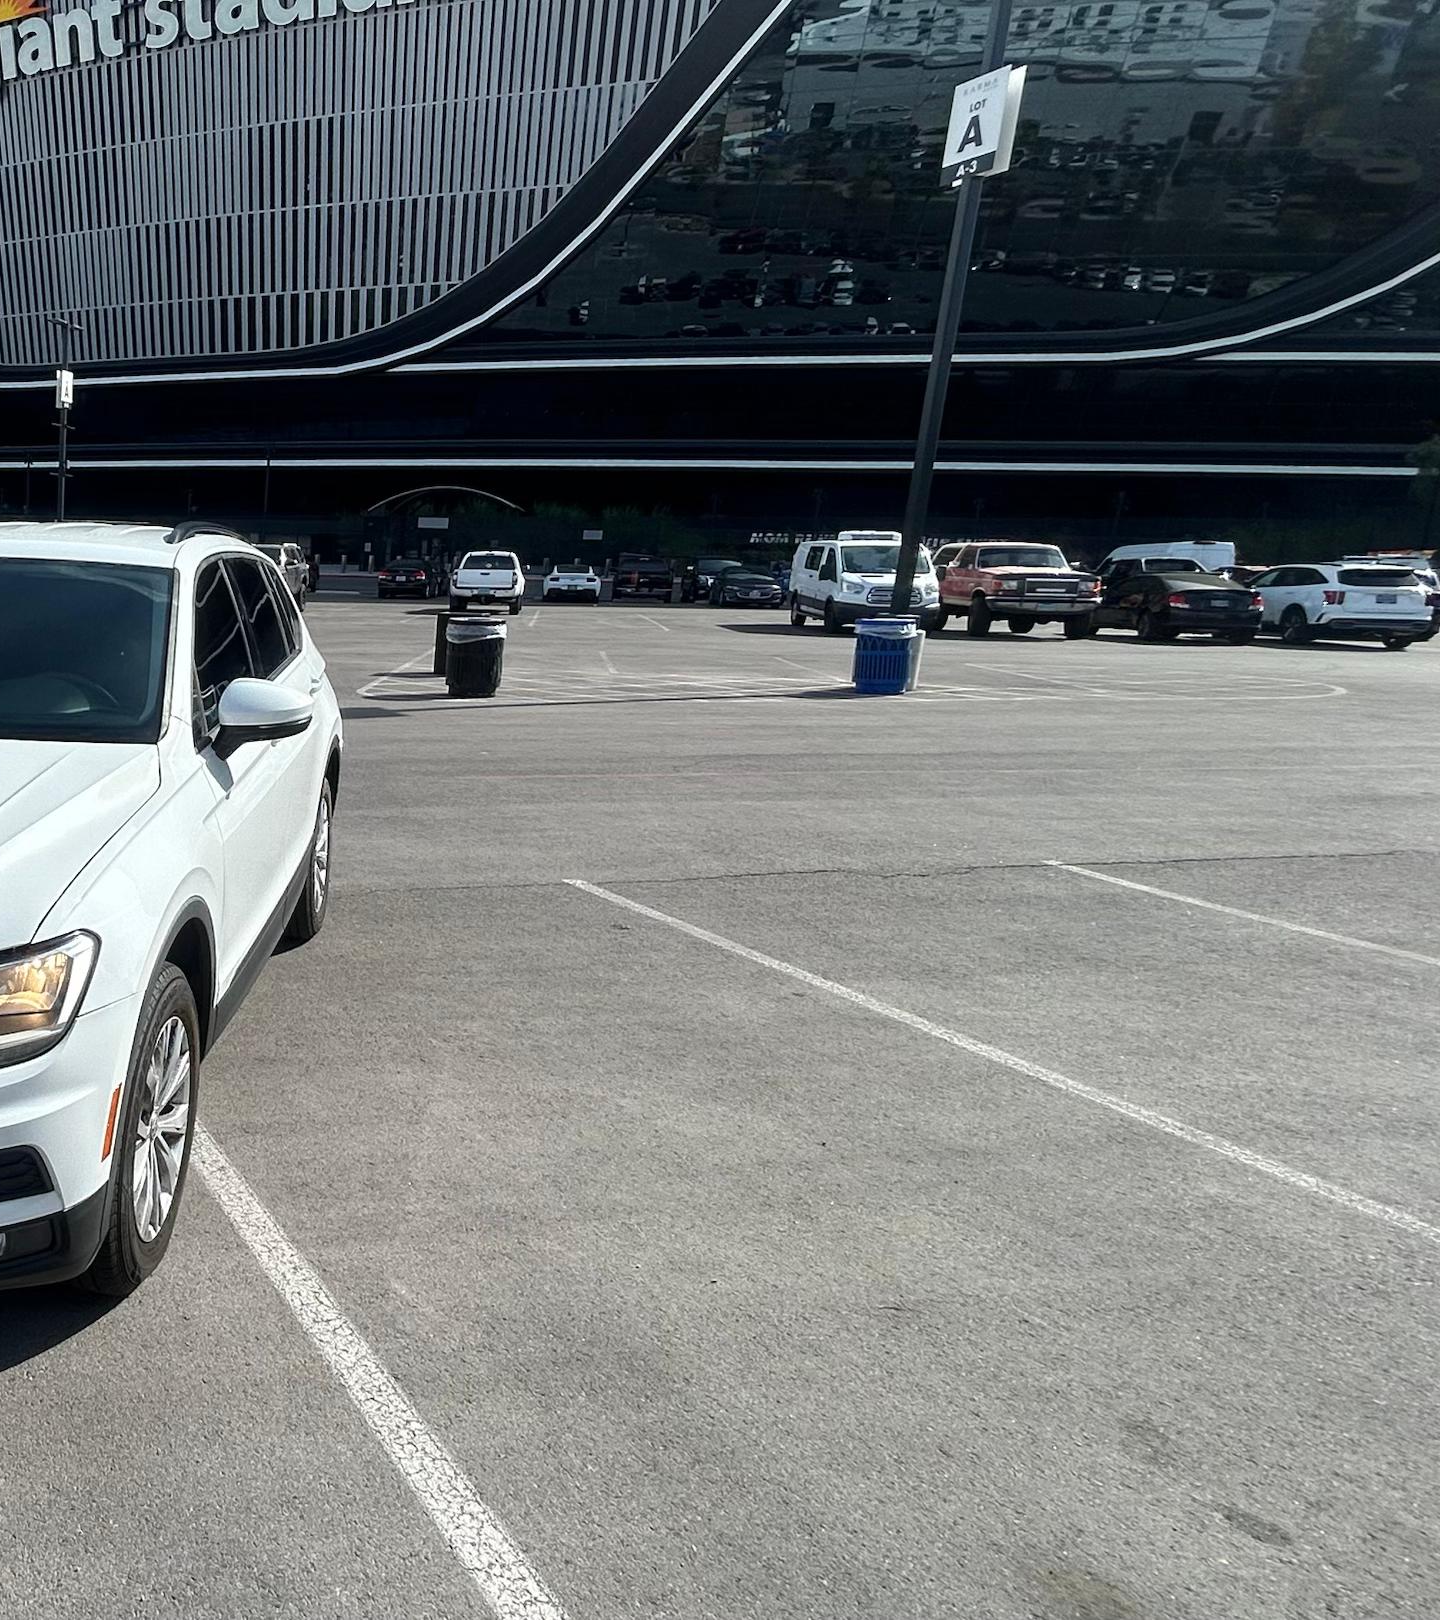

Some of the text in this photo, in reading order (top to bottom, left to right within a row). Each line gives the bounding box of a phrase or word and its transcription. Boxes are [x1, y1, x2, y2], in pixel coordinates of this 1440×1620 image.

[969, 98, 988, 113] LOT
[956, 115, 983, 153] A
[956, 160, 978, 177] A-3
